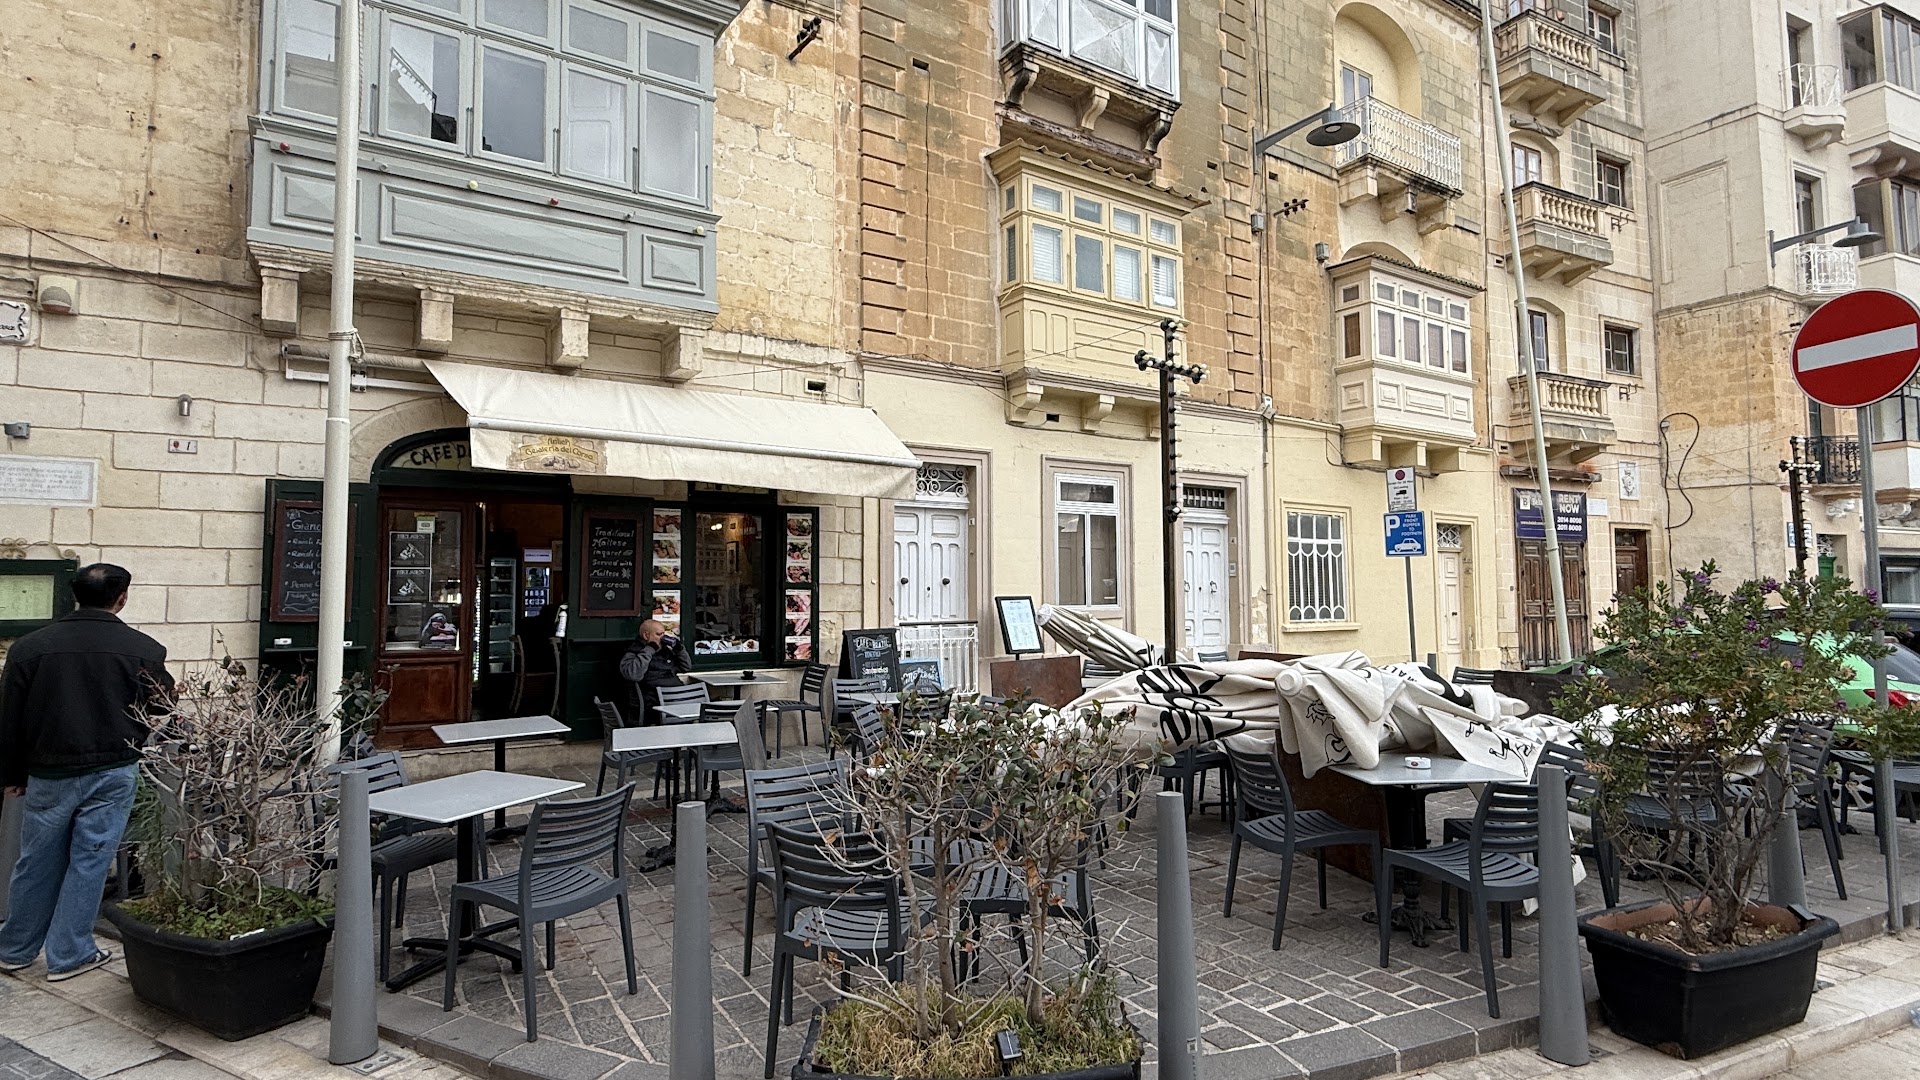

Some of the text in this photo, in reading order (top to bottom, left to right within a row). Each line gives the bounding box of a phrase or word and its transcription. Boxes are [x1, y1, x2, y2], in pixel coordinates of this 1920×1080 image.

[410, 443, 471, 465] CAFE D
[525, 445, 594, 460] Gelateria del Corso
[1558, 494, 1580, 504] RENT
[1560, 504, 1580, 514] NOW
[1385, 515, 1400, 536] P
[594, 526, 635, 538] Traditional
[591, 537, 627, 548] Maltese
